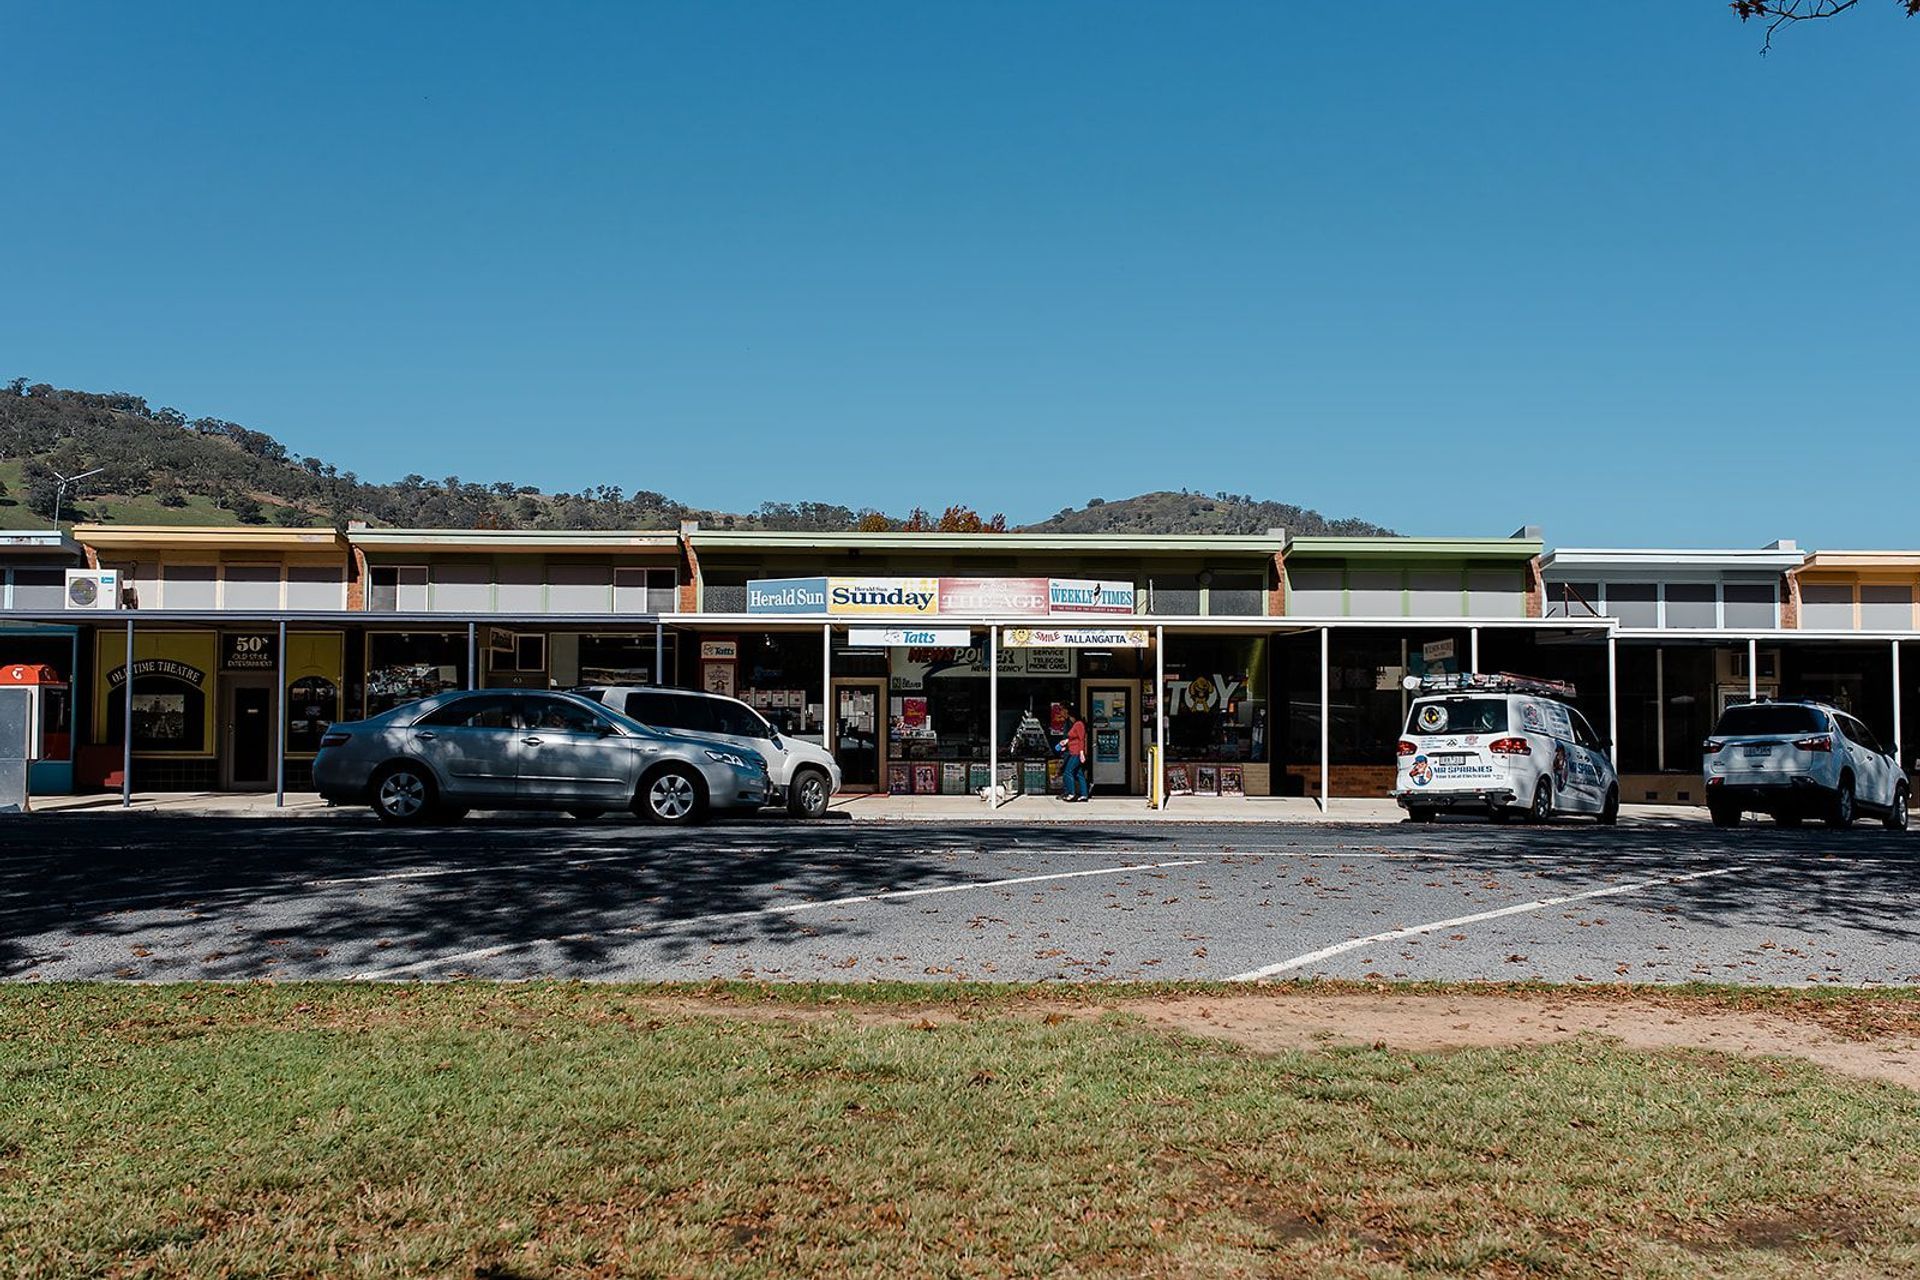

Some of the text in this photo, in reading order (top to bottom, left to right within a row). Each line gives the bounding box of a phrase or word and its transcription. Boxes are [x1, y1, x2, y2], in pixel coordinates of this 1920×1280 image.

[750, 588, 825, 607] Herald Sun
[832, 587, 935, 610] Sunday
[998, 594, 1045, 608] AGE
[1051, 588, 1133, 605] WEEKLY TIMES
[903, 631, 936, 644] Tatts
[1034, 631, 1127, 644] SMILE TALLANGATTA
[714, 646, 735, 656] Tatts
[133, 661, 156, 674] TIME
[157, 661, 201, 682] THEATRE
[1166, 673, 1240, 716] TOY
